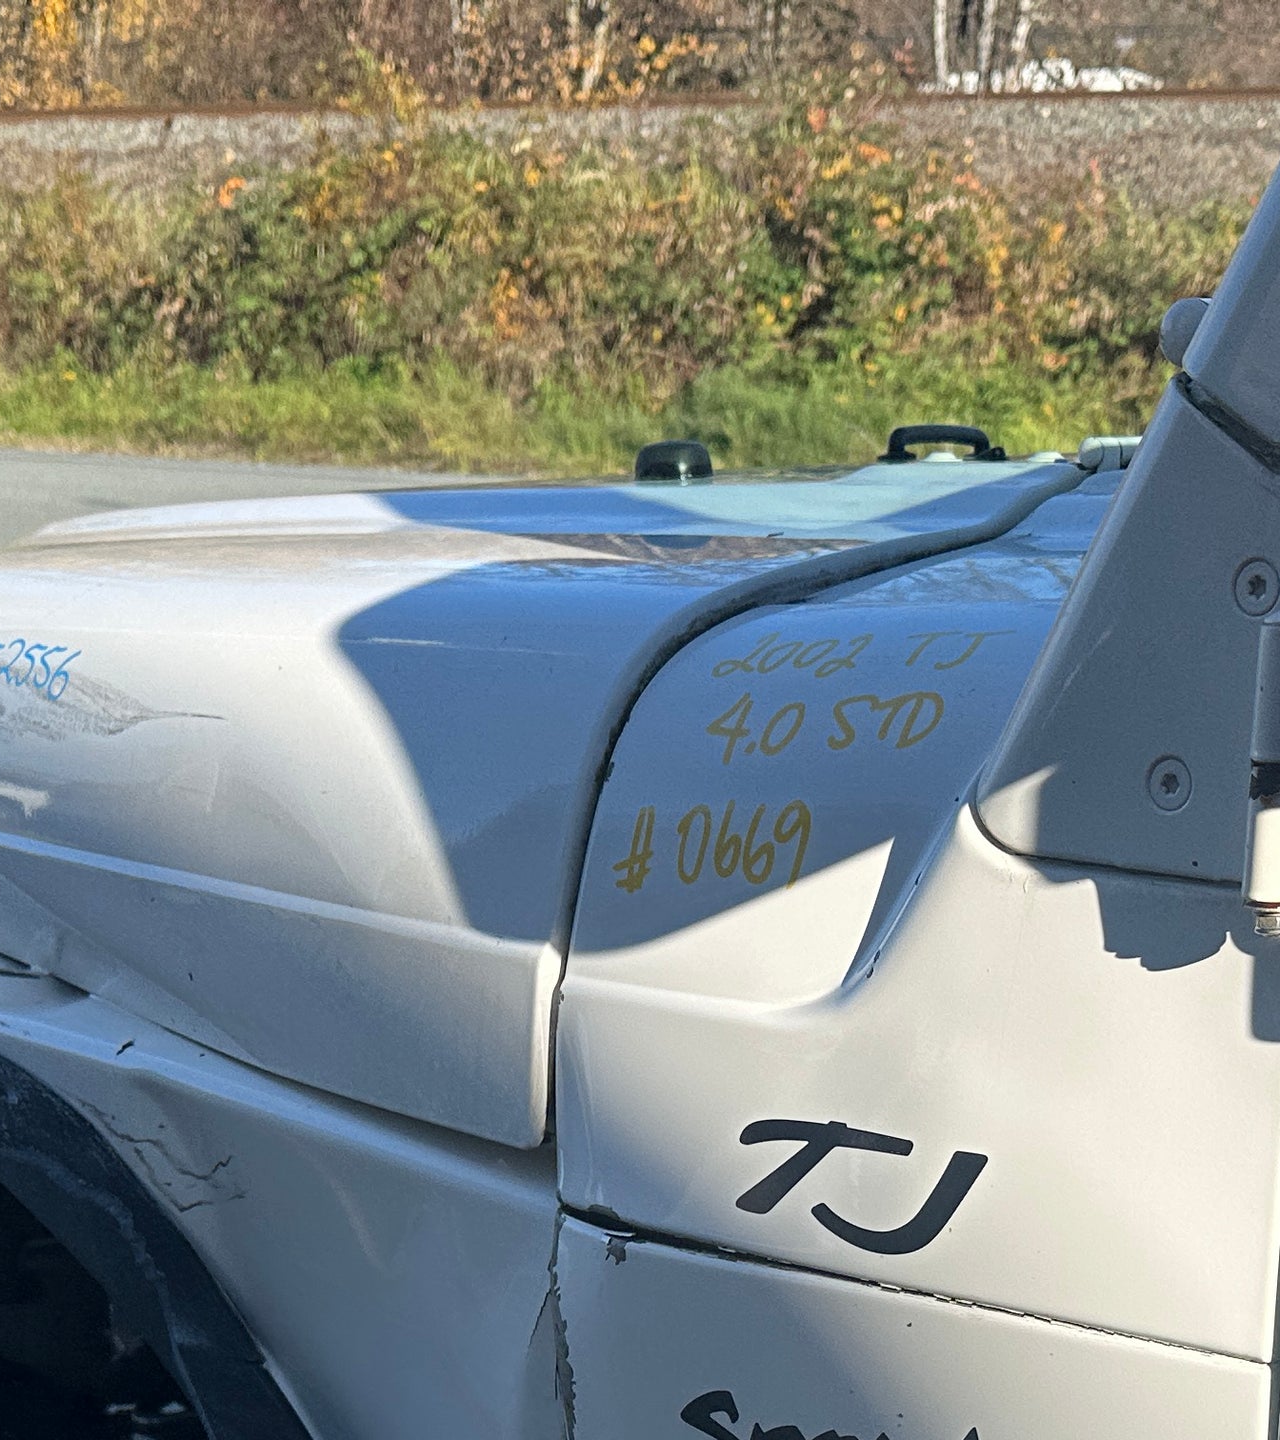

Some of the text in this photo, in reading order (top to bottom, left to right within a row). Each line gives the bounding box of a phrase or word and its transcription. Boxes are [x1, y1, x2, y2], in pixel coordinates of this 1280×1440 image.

[711, 629, 1017, 679] 2002 TJ
[706, 691, 945, 766] 4.0 STD
[736, 1119, 989, 1255] TJ
